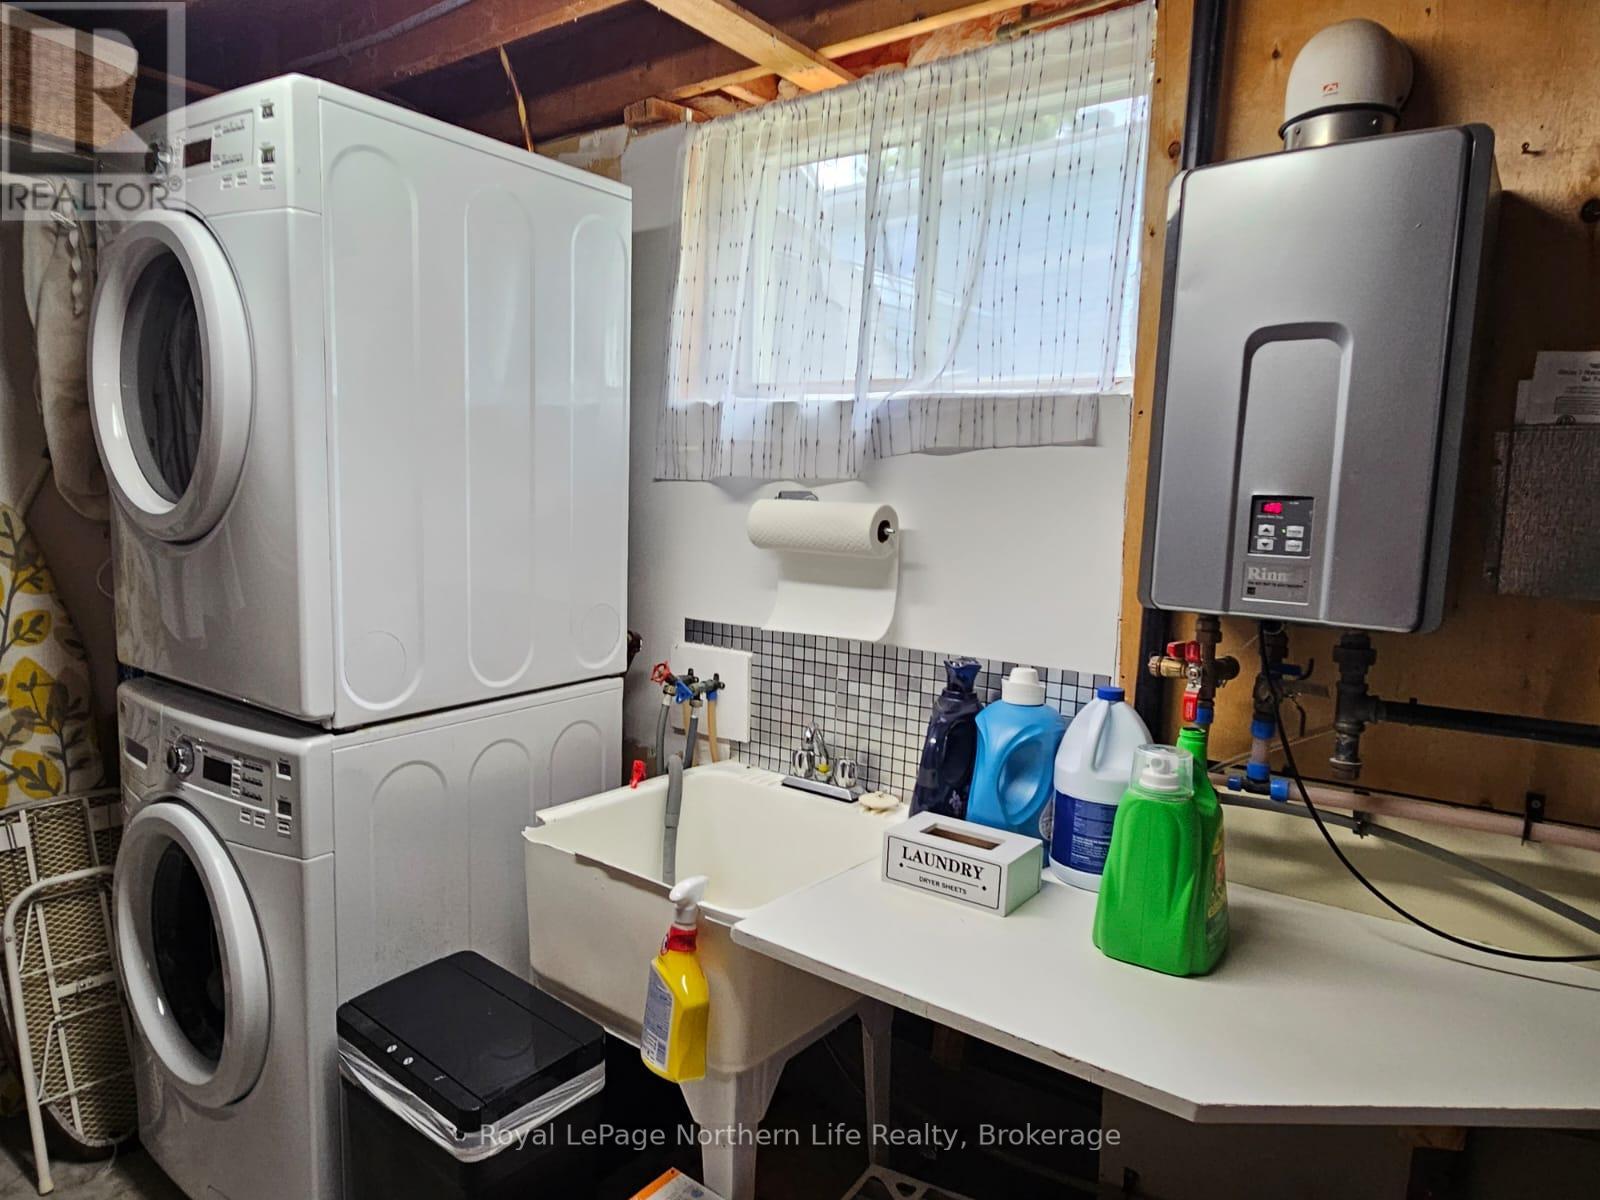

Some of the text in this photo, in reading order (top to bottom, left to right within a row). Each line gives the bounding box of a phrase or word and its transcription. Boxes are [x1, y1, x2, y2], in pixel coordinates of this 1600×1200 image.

[902, 846, 985, 880] LAUNDRY
[919, 875, 967, 895] DRYER SHEETS
